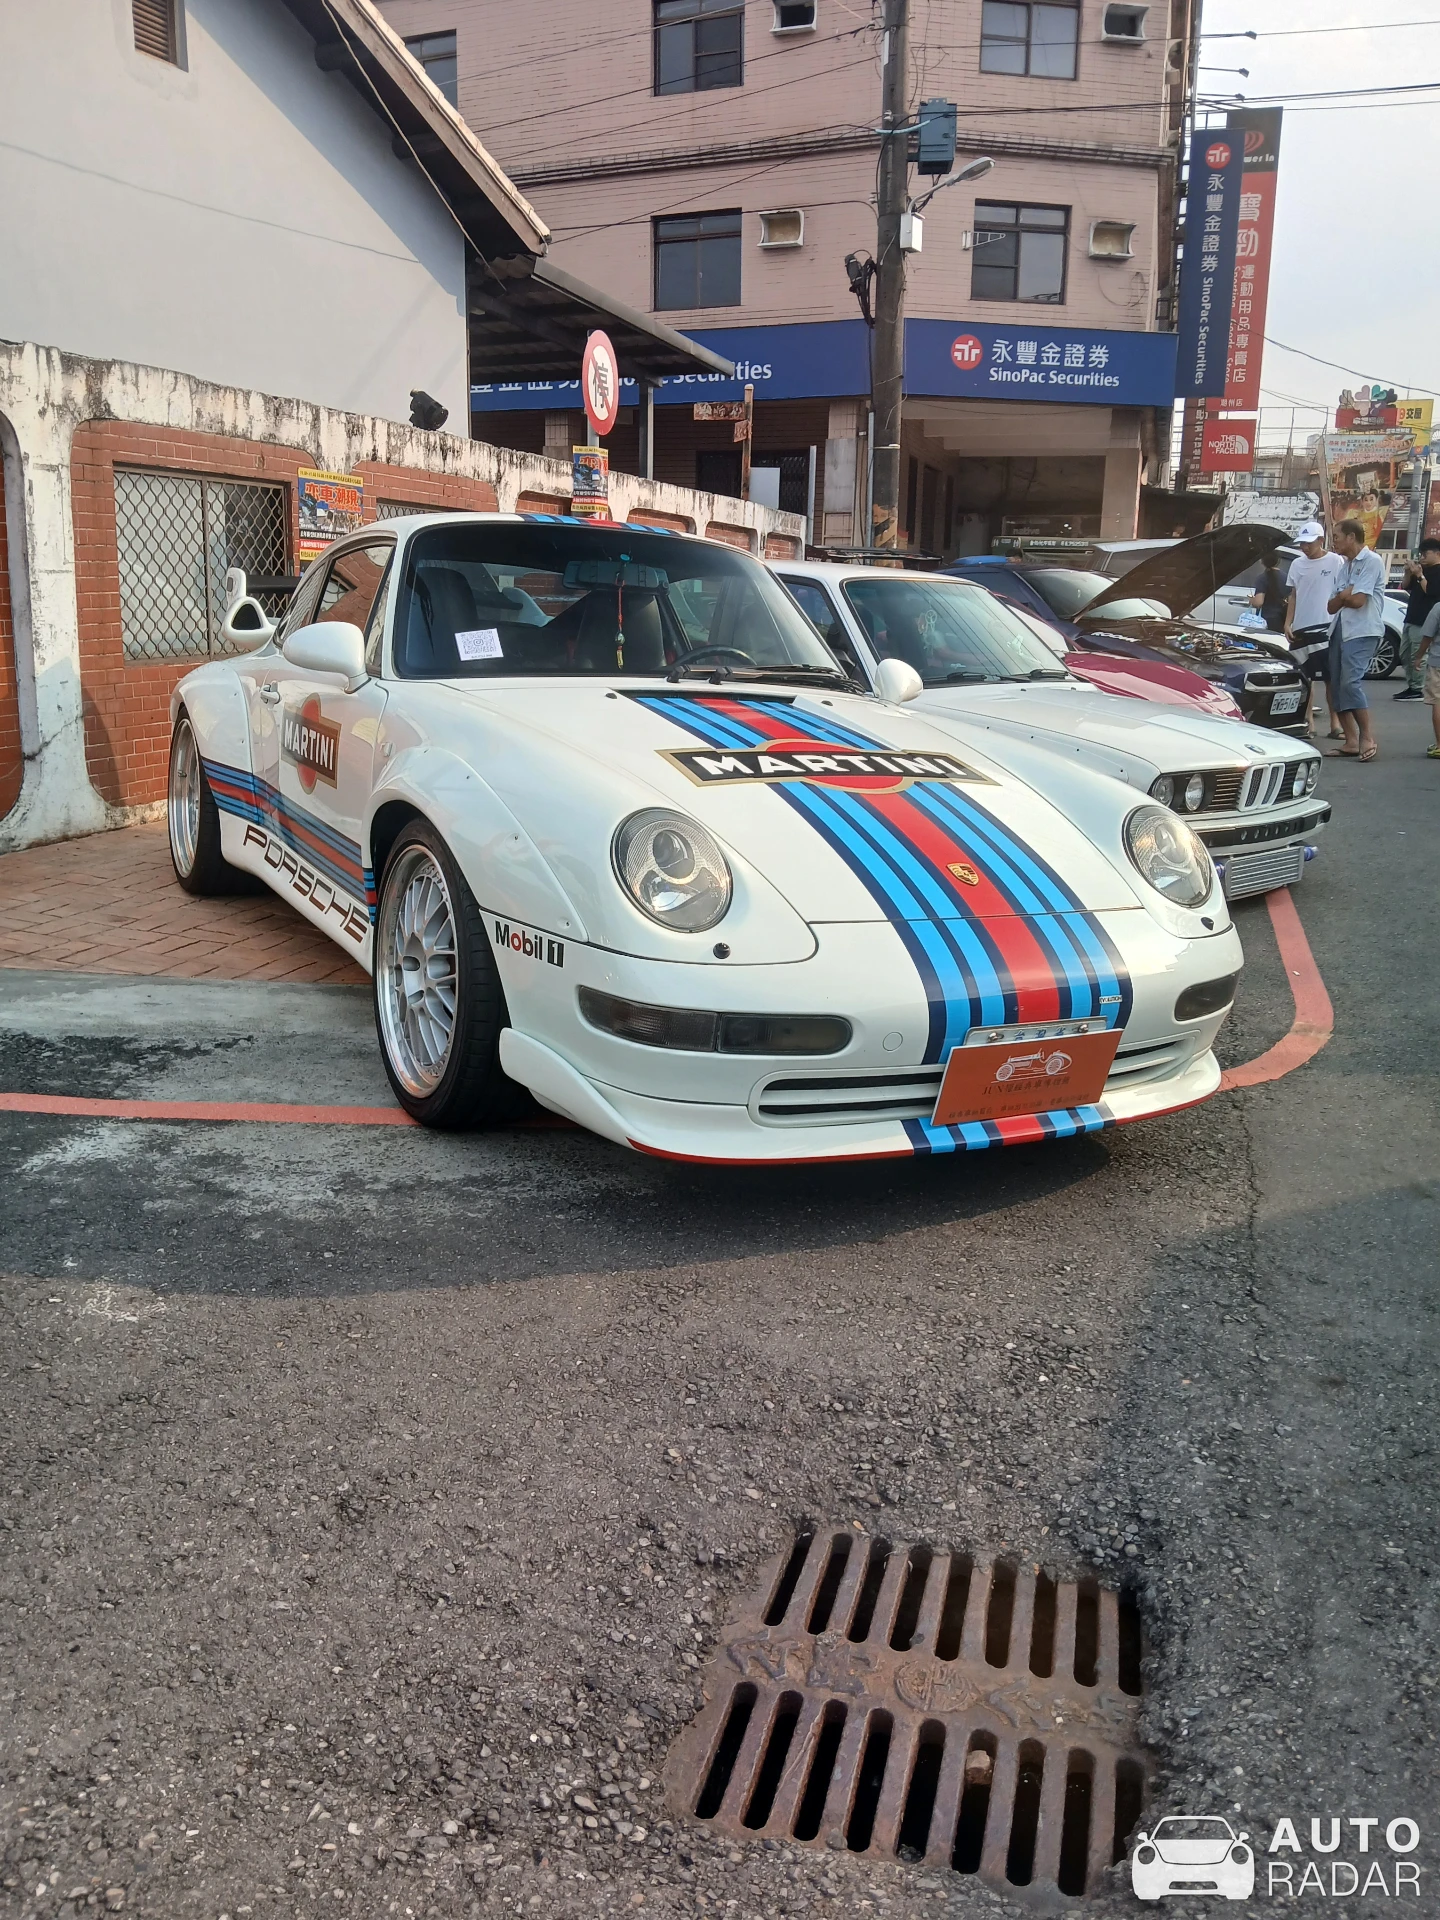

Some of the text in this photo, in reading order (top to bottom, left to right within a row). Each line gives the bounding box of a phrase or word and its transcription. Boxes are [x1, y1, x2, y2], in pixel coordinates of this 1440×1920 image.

[1201, 173, 1225, 272] 永豐金證券
[1200, 276, 1214, 324] SinoPac
[1232, 264, 1255, 383] 運動用品專賣店
[988, 366, 1120, 387] SinoPac Securities
[991, 339, 1110, 369] 永豐金證券
[1195, 325, 1210, 385] Securities
[592, 361, 609, 409] 停
[1215, 447, 1236, 455] FACE
[1220, 434, 1236, 442] THE
[284, 718, 335, 771] MARTINI
[691, 754, 968, 776] MARTINI
[243, 824, 370, 944] PORSCHE
[495, 920, 543, 961] Mobil
